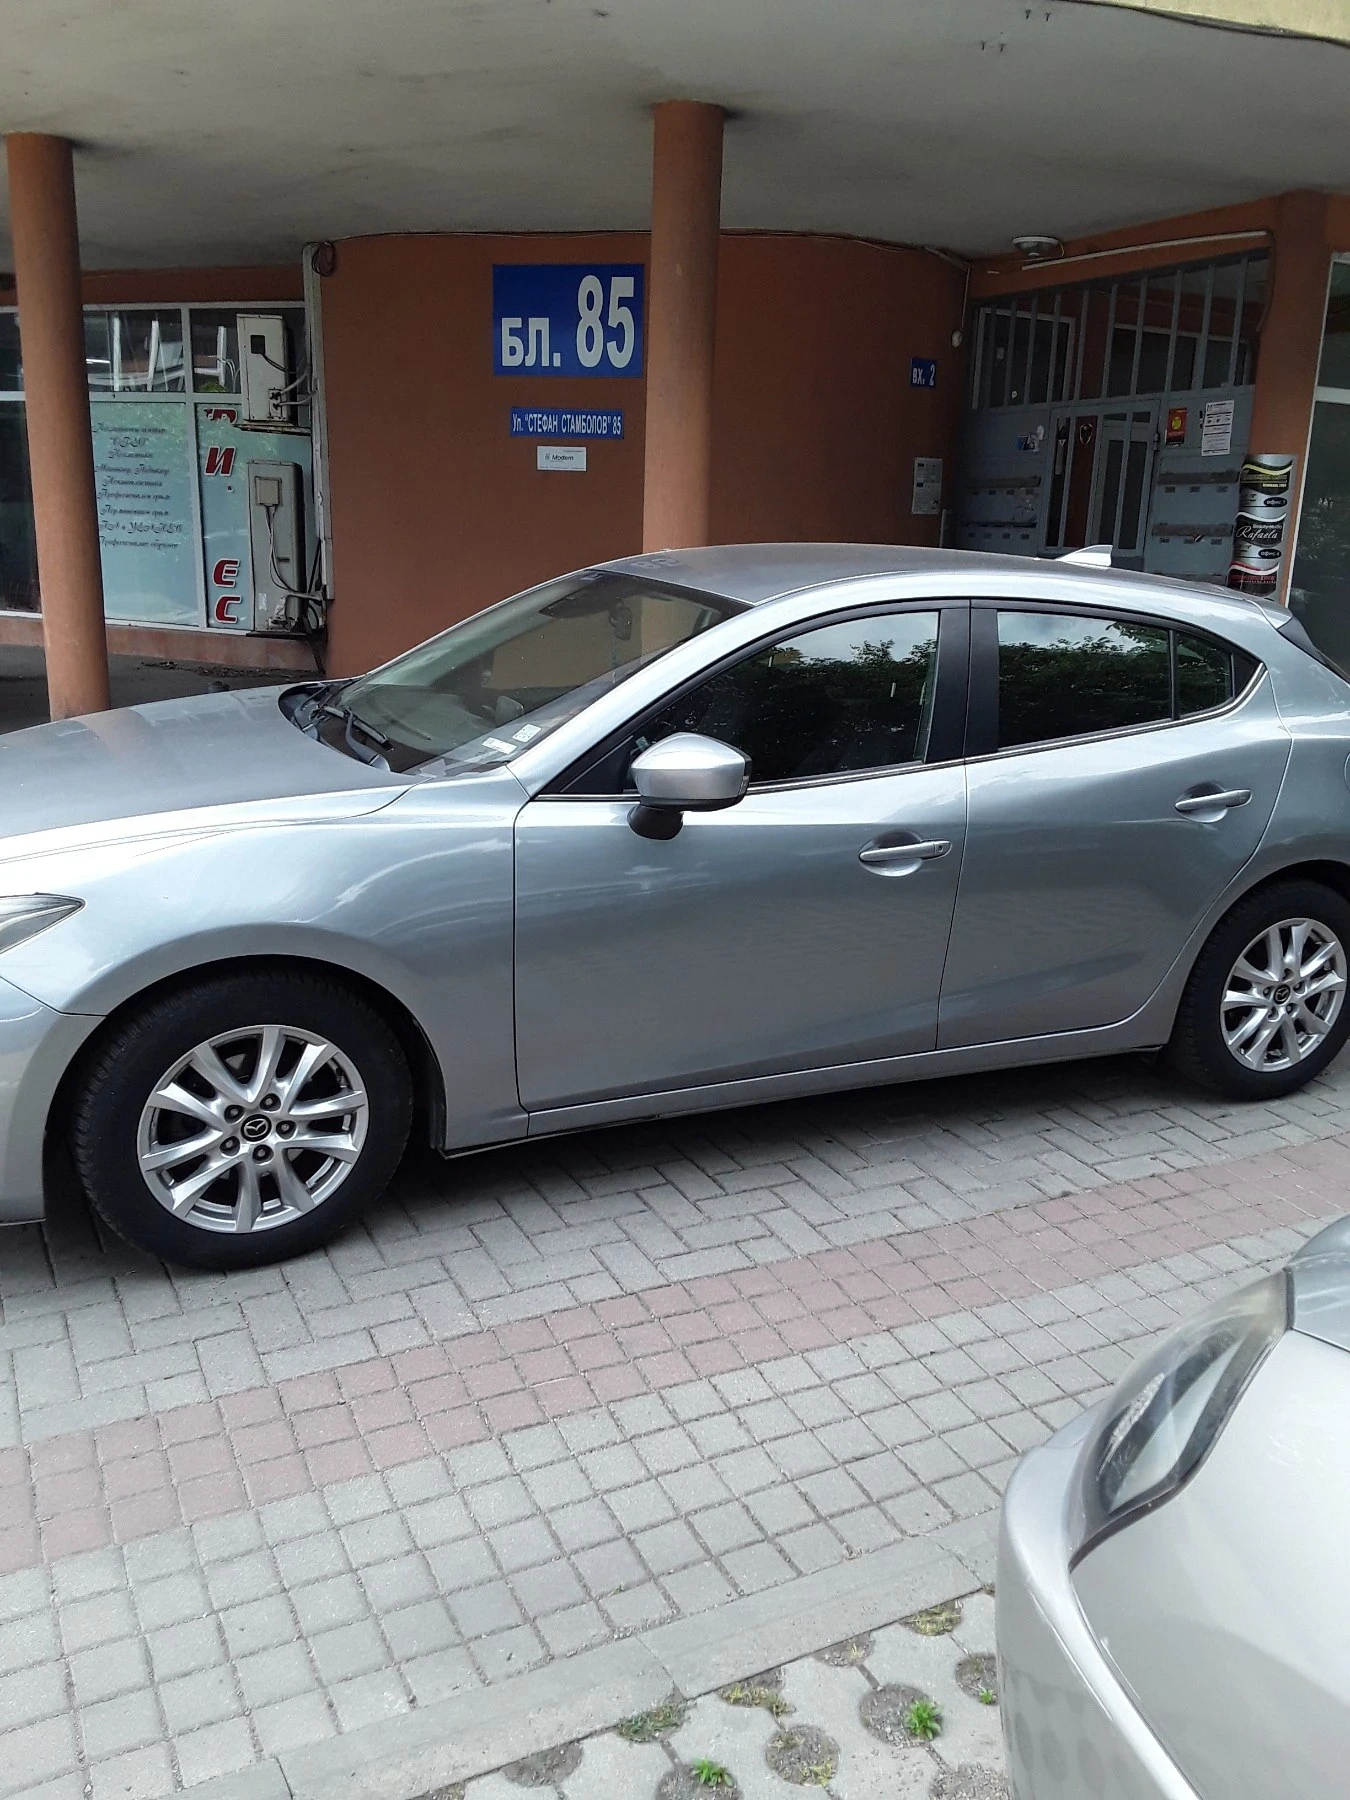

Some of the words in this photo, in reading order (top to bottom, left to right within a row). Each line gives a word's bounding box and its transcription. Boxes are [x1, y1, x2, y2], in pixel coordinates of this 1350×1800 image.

[501, 317, 561, 367] БЛ.
[576, 274, 635, 369] 85
[929, 364, 936, 386] 2
[612, 416, 622, 436] 85
[1235, 525, 1279, 541] Rafaela
